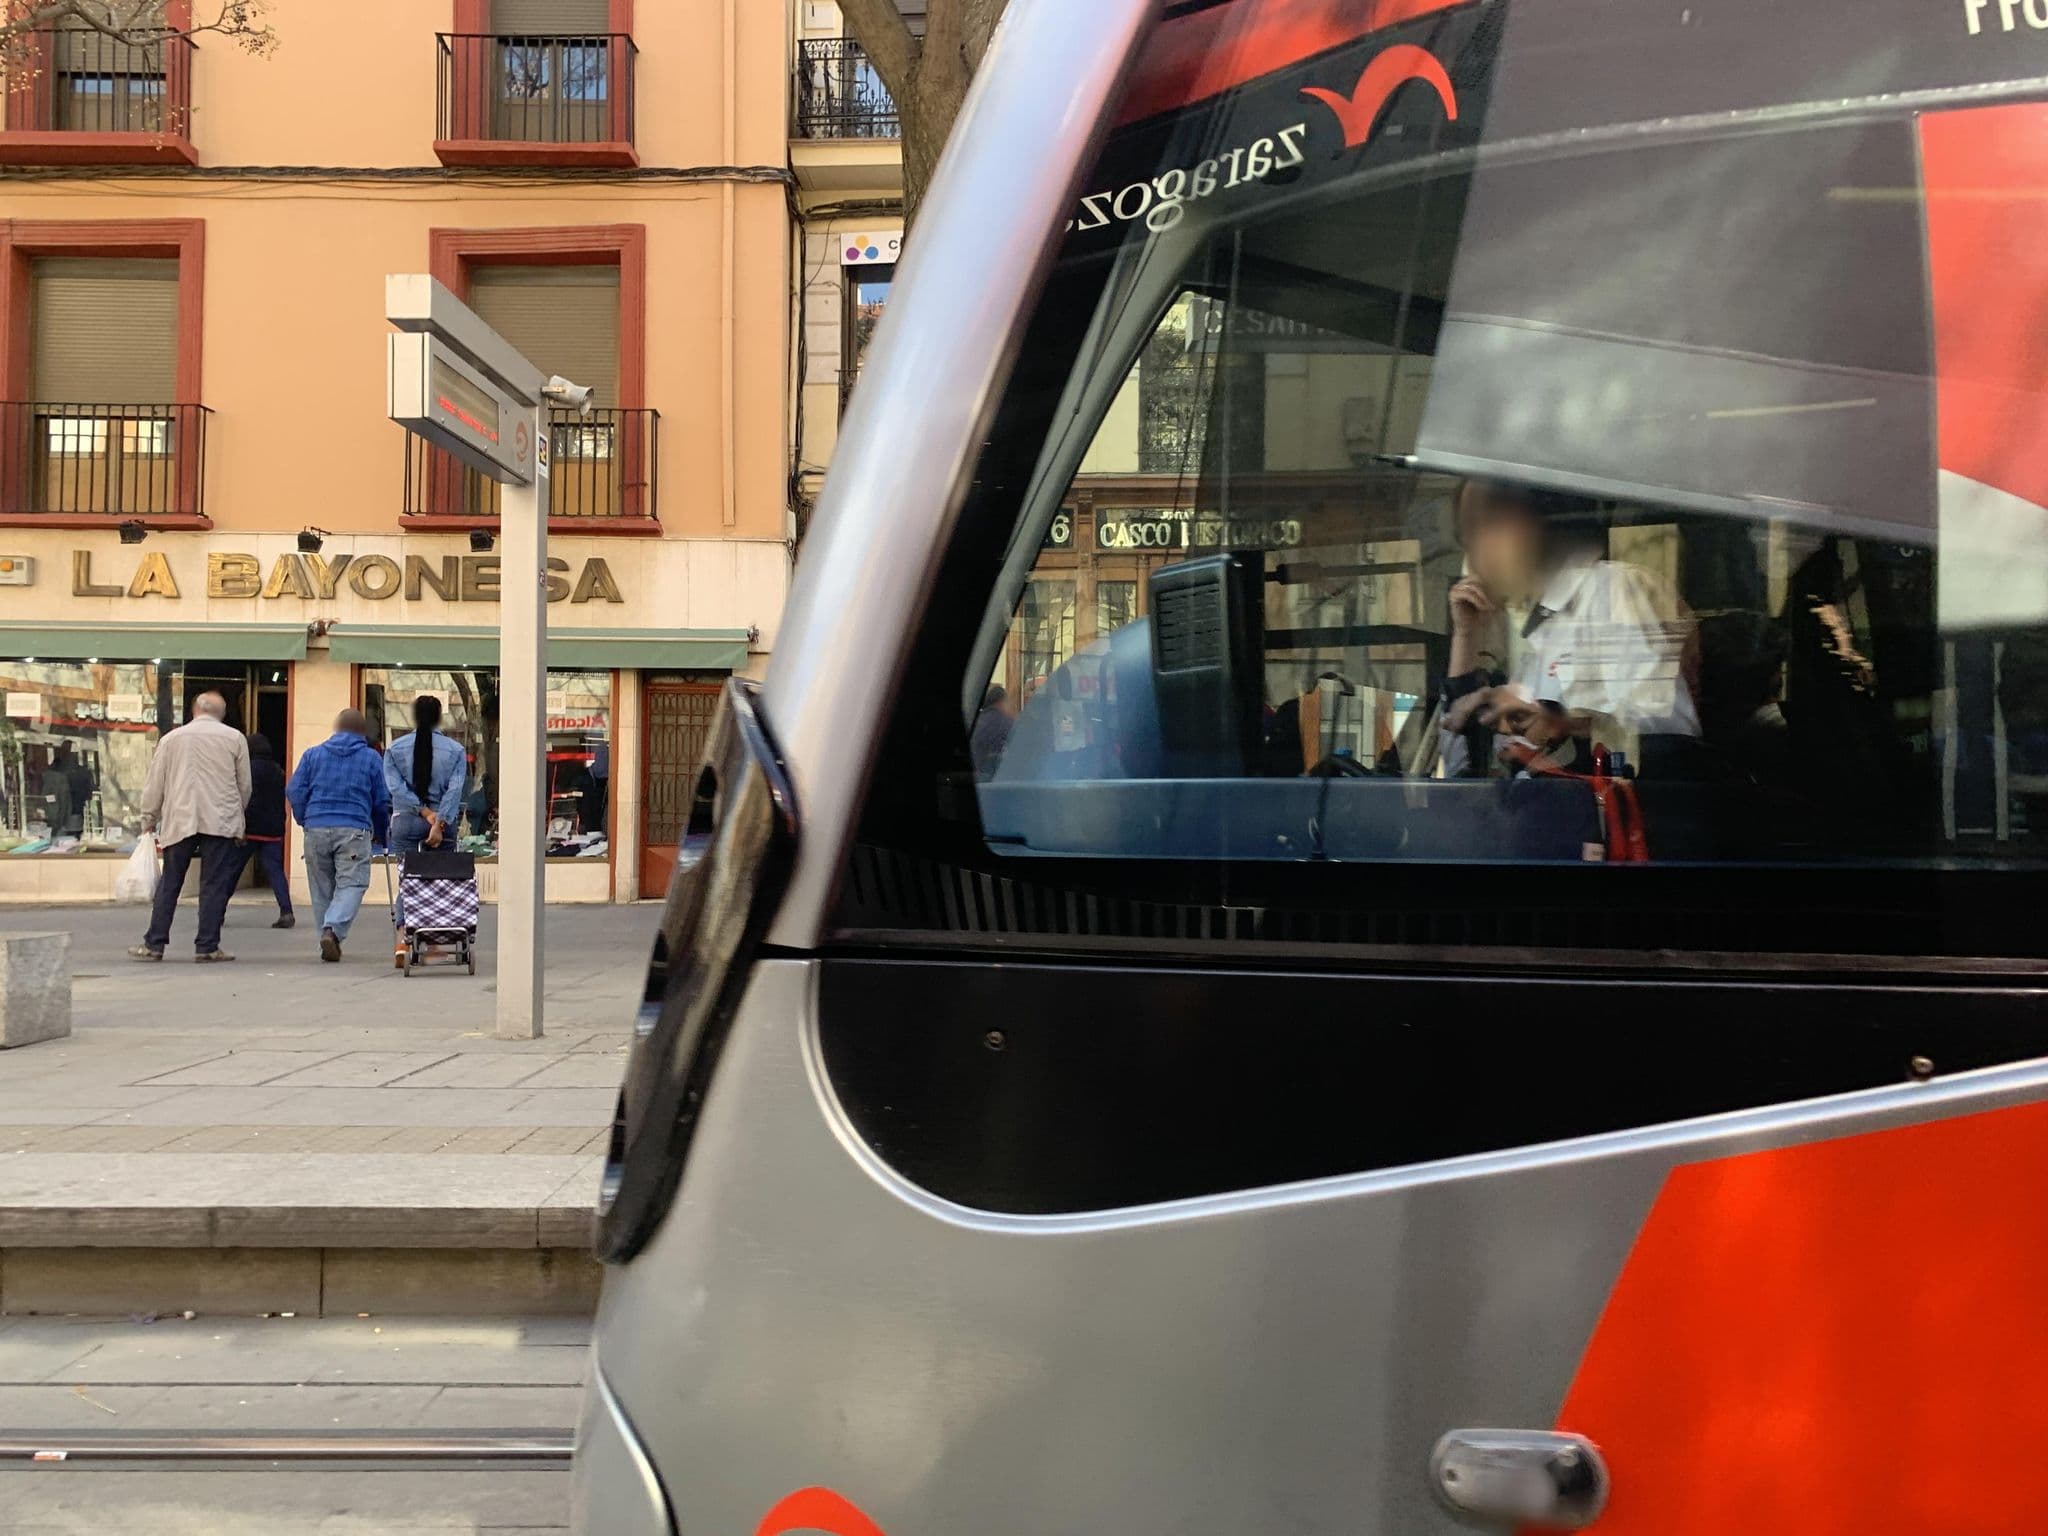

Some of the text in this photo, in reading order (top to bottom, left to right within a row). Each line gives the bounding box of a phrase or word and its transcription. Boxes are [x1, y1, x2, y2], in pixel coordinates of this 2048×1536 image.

[1100, 522, 1172, 548] CASCO
[73, 550, 625, 604] LA BAYONESA
